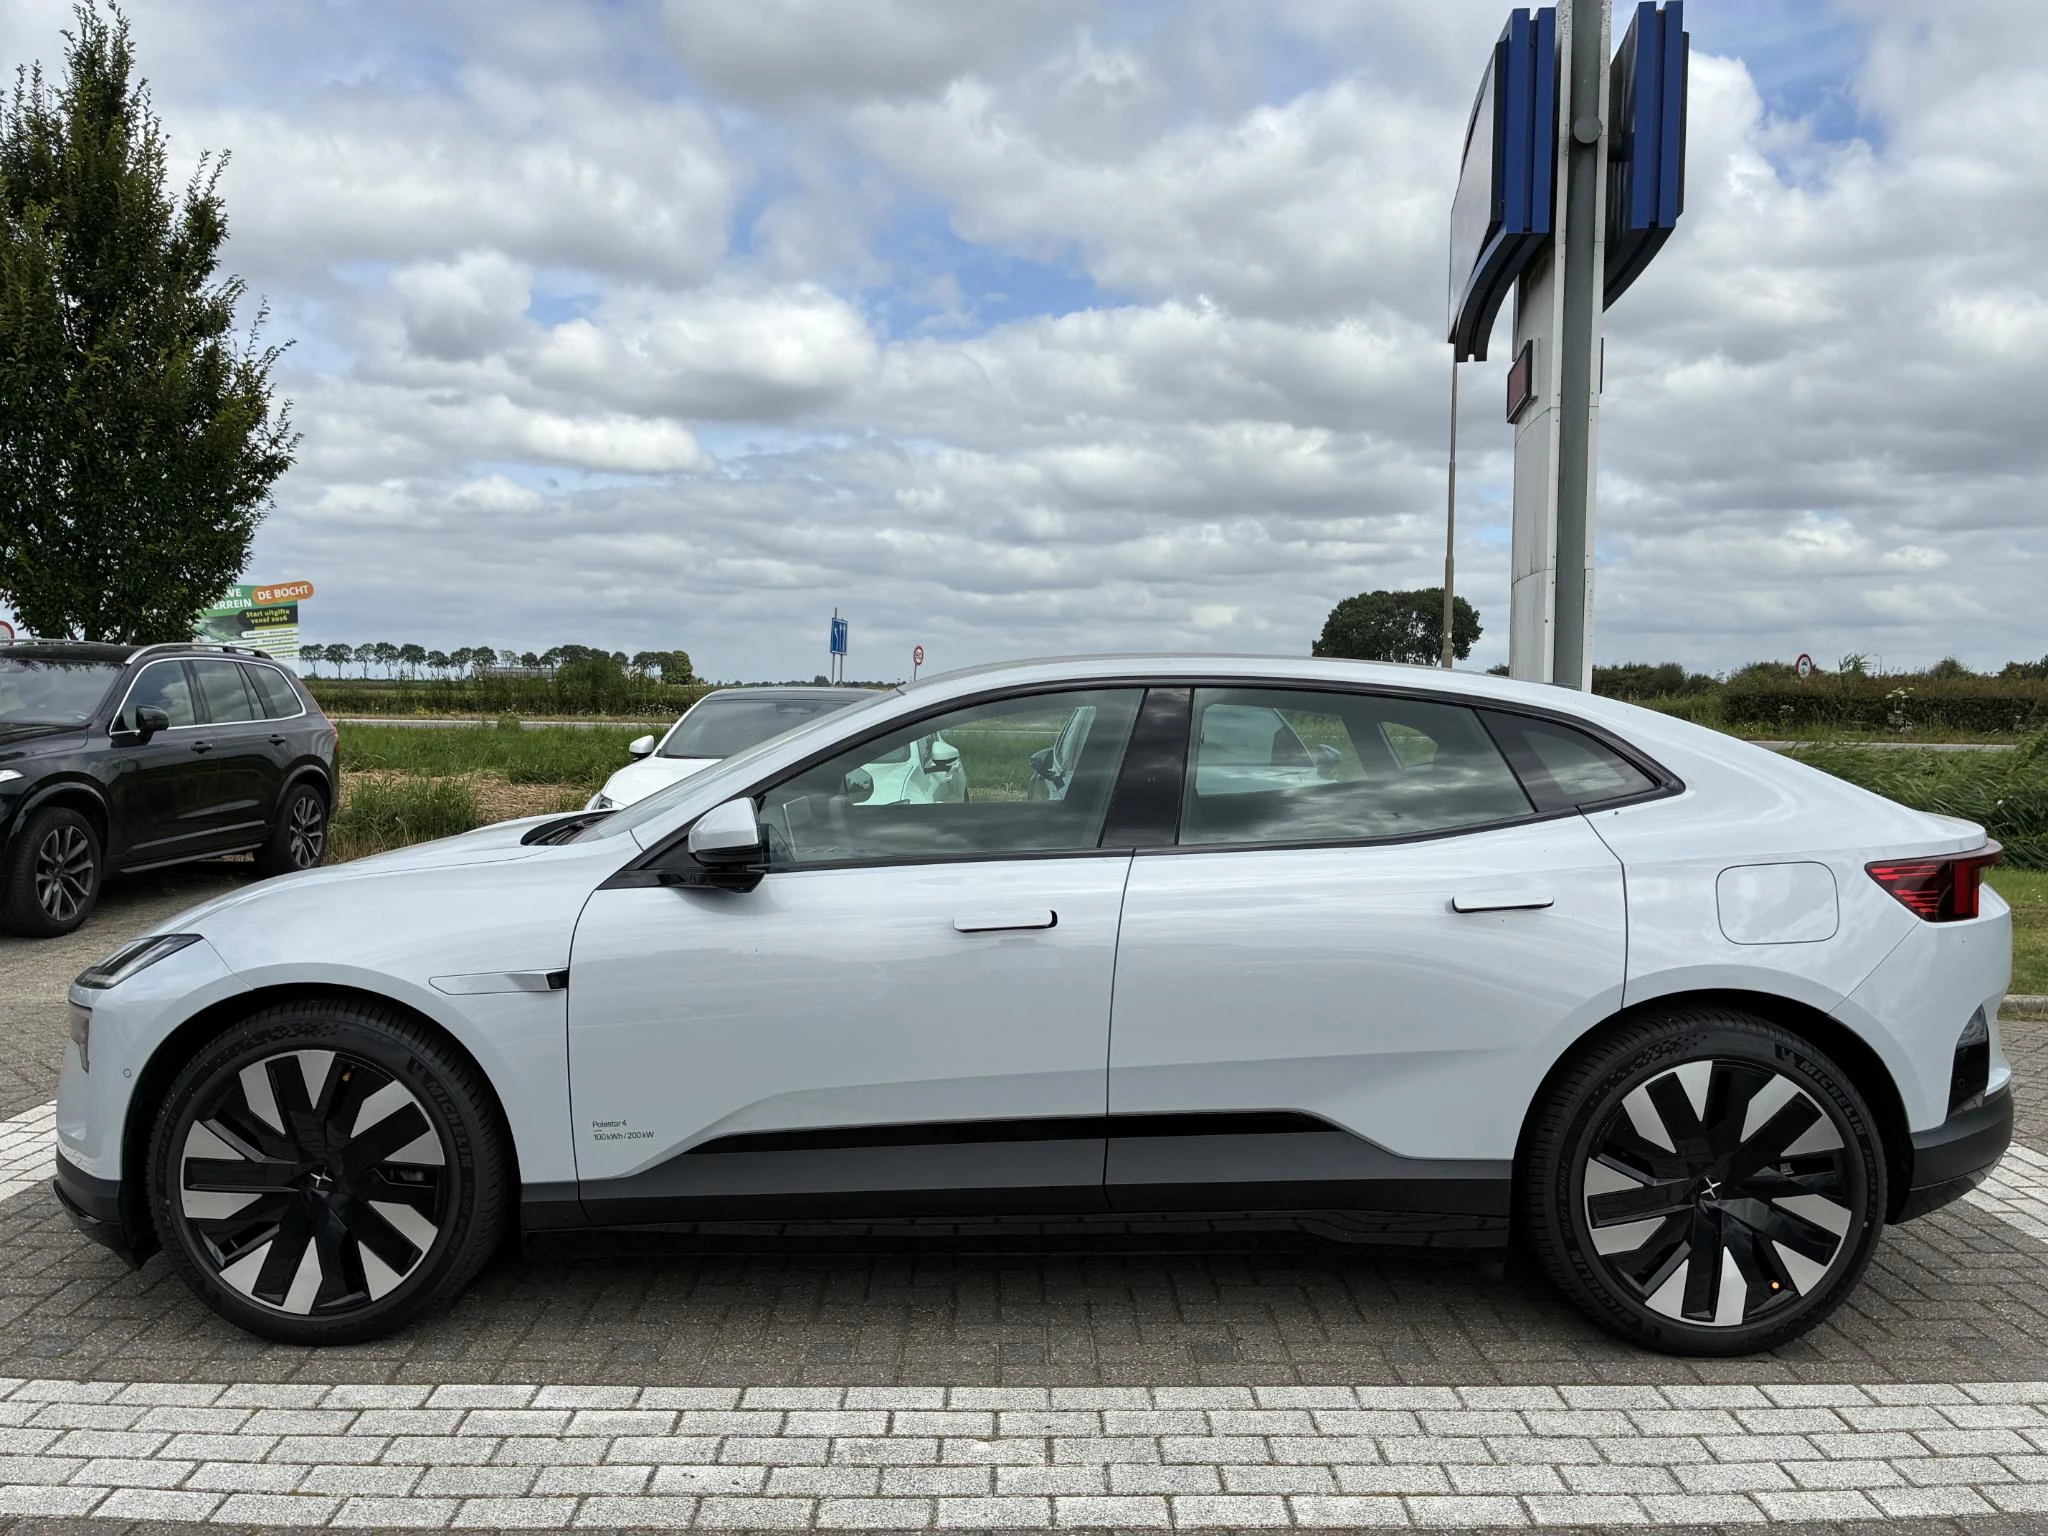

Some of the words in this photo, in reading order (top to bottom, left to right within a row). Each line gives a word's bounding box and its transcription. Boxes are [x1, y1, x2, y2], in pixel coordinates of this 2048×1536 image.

[257, 590, 272, 600] DE
[274, 585, 309, 598] BOCHT
[213, 598, 252, 610] ERREIN
[246, 610, 263, 618] Start
[264, 608, 290, 617] uitgifte
[250, 616, 270, 625] vanaf
[1799, 1060, 1867, 1137] MICHELIN
[427, 1079, 473, 1169] MICHELIN
[592, 1120, 621, 1128] Polestar
[593, 1133, 606, 1141] 100
[627, 1131, 642, 1139] 200
[642, 1130, 655, 1138] kW
[1558, 1159, 1571, 1201] SPORT
[1569, 1249, 1640, 1325] MICHELIN
